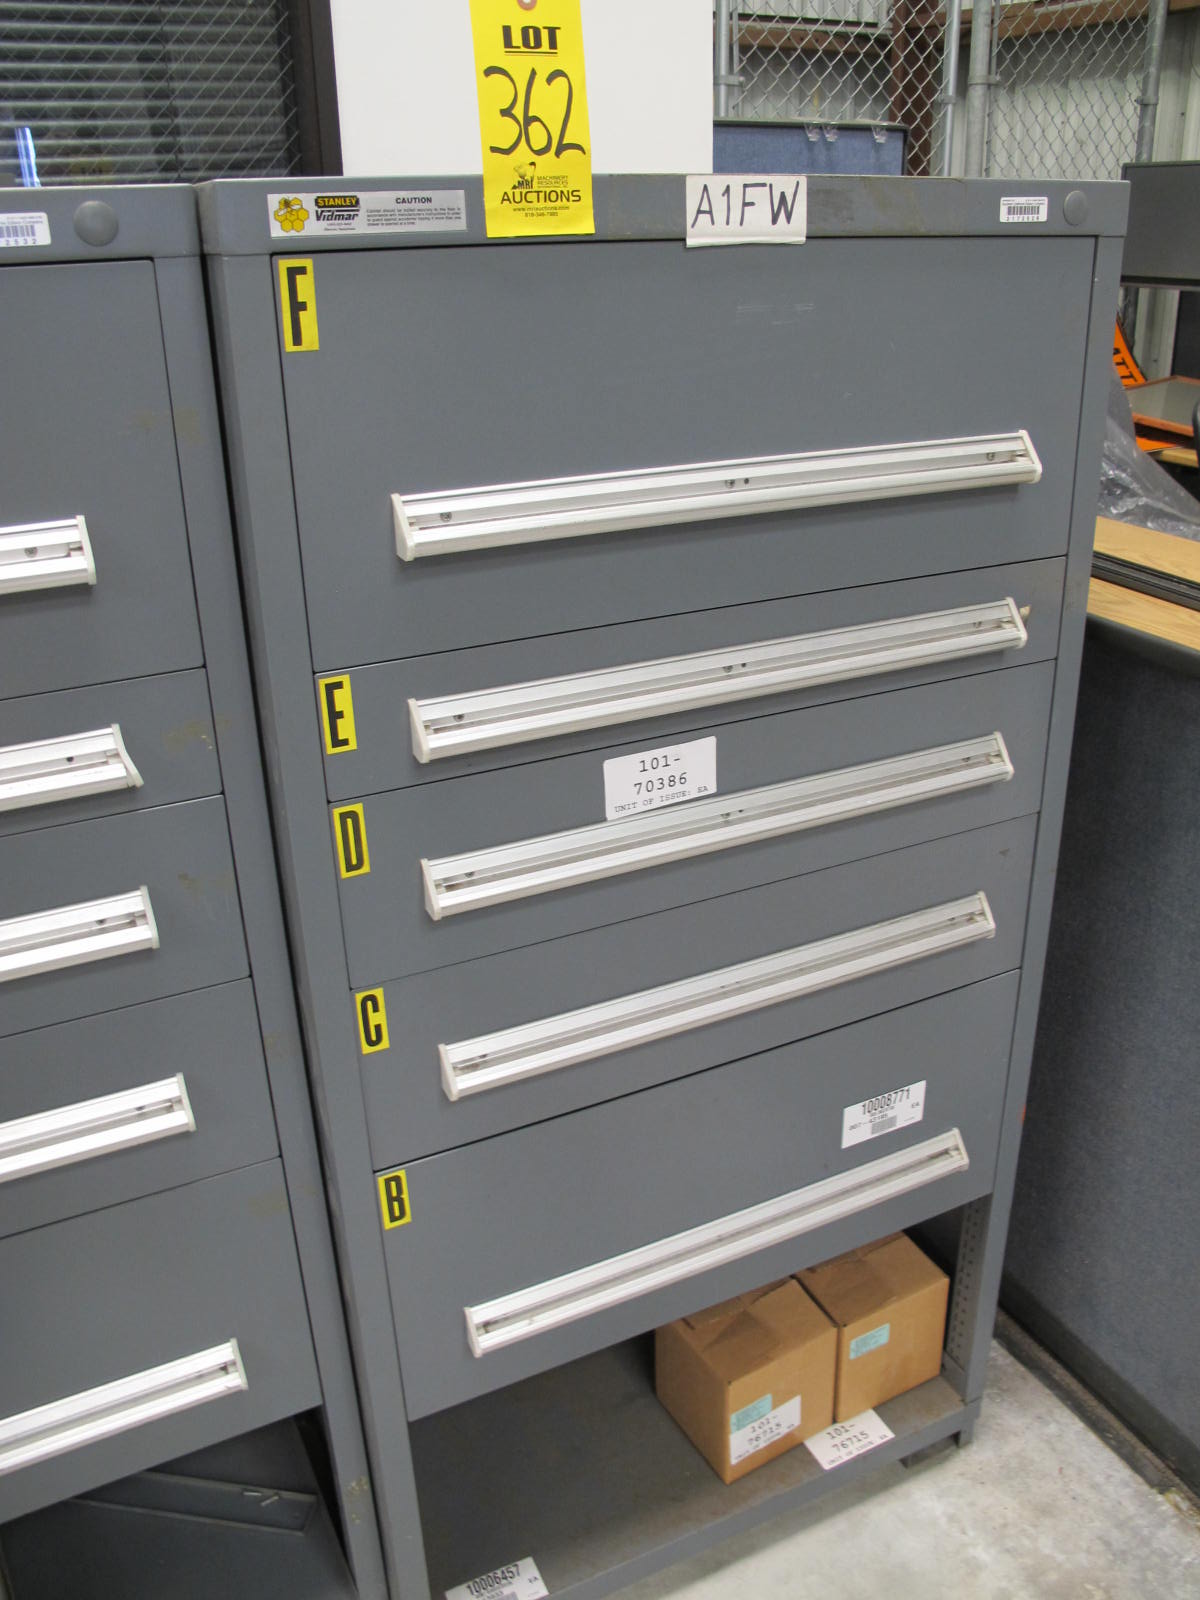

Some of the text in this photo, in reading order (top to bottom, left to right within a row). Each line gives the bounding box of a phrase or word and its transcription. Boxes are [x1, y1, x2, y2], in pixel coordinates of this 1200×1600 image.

[502, 25, 561, 50] LOT
[483, 65, 586, 159] 362
[317, 196, 358, 206] STANLEY
[395, 196, 433, 204] CAUTION
[500, 189, 582, 205] AUCTIONS
[691, 180, 800, 229] A1FW
[315, 209, 359, 221] Vidmar
[286, 266, 307, 346] F
[324, 680, 350, 749] E
[639, 755, 681, 773] 101-
[634, 772, 688, 796] 70386
[614, 801, 638, 813] UNIT
[642, 798, 654, 807] OF
[697, 785, 709, 794] EA
[339, 810, 365, 873] D
[360, 993, 384, 1047] C
[861, 1087, 911, 1115] 10008771
[384, 1174, 406, 1223] B
[825, 1424, 856, 1439] 101-
[831, 1430, 870, 1452] 76715
[466, 1563, 521, 1596] 10006457
